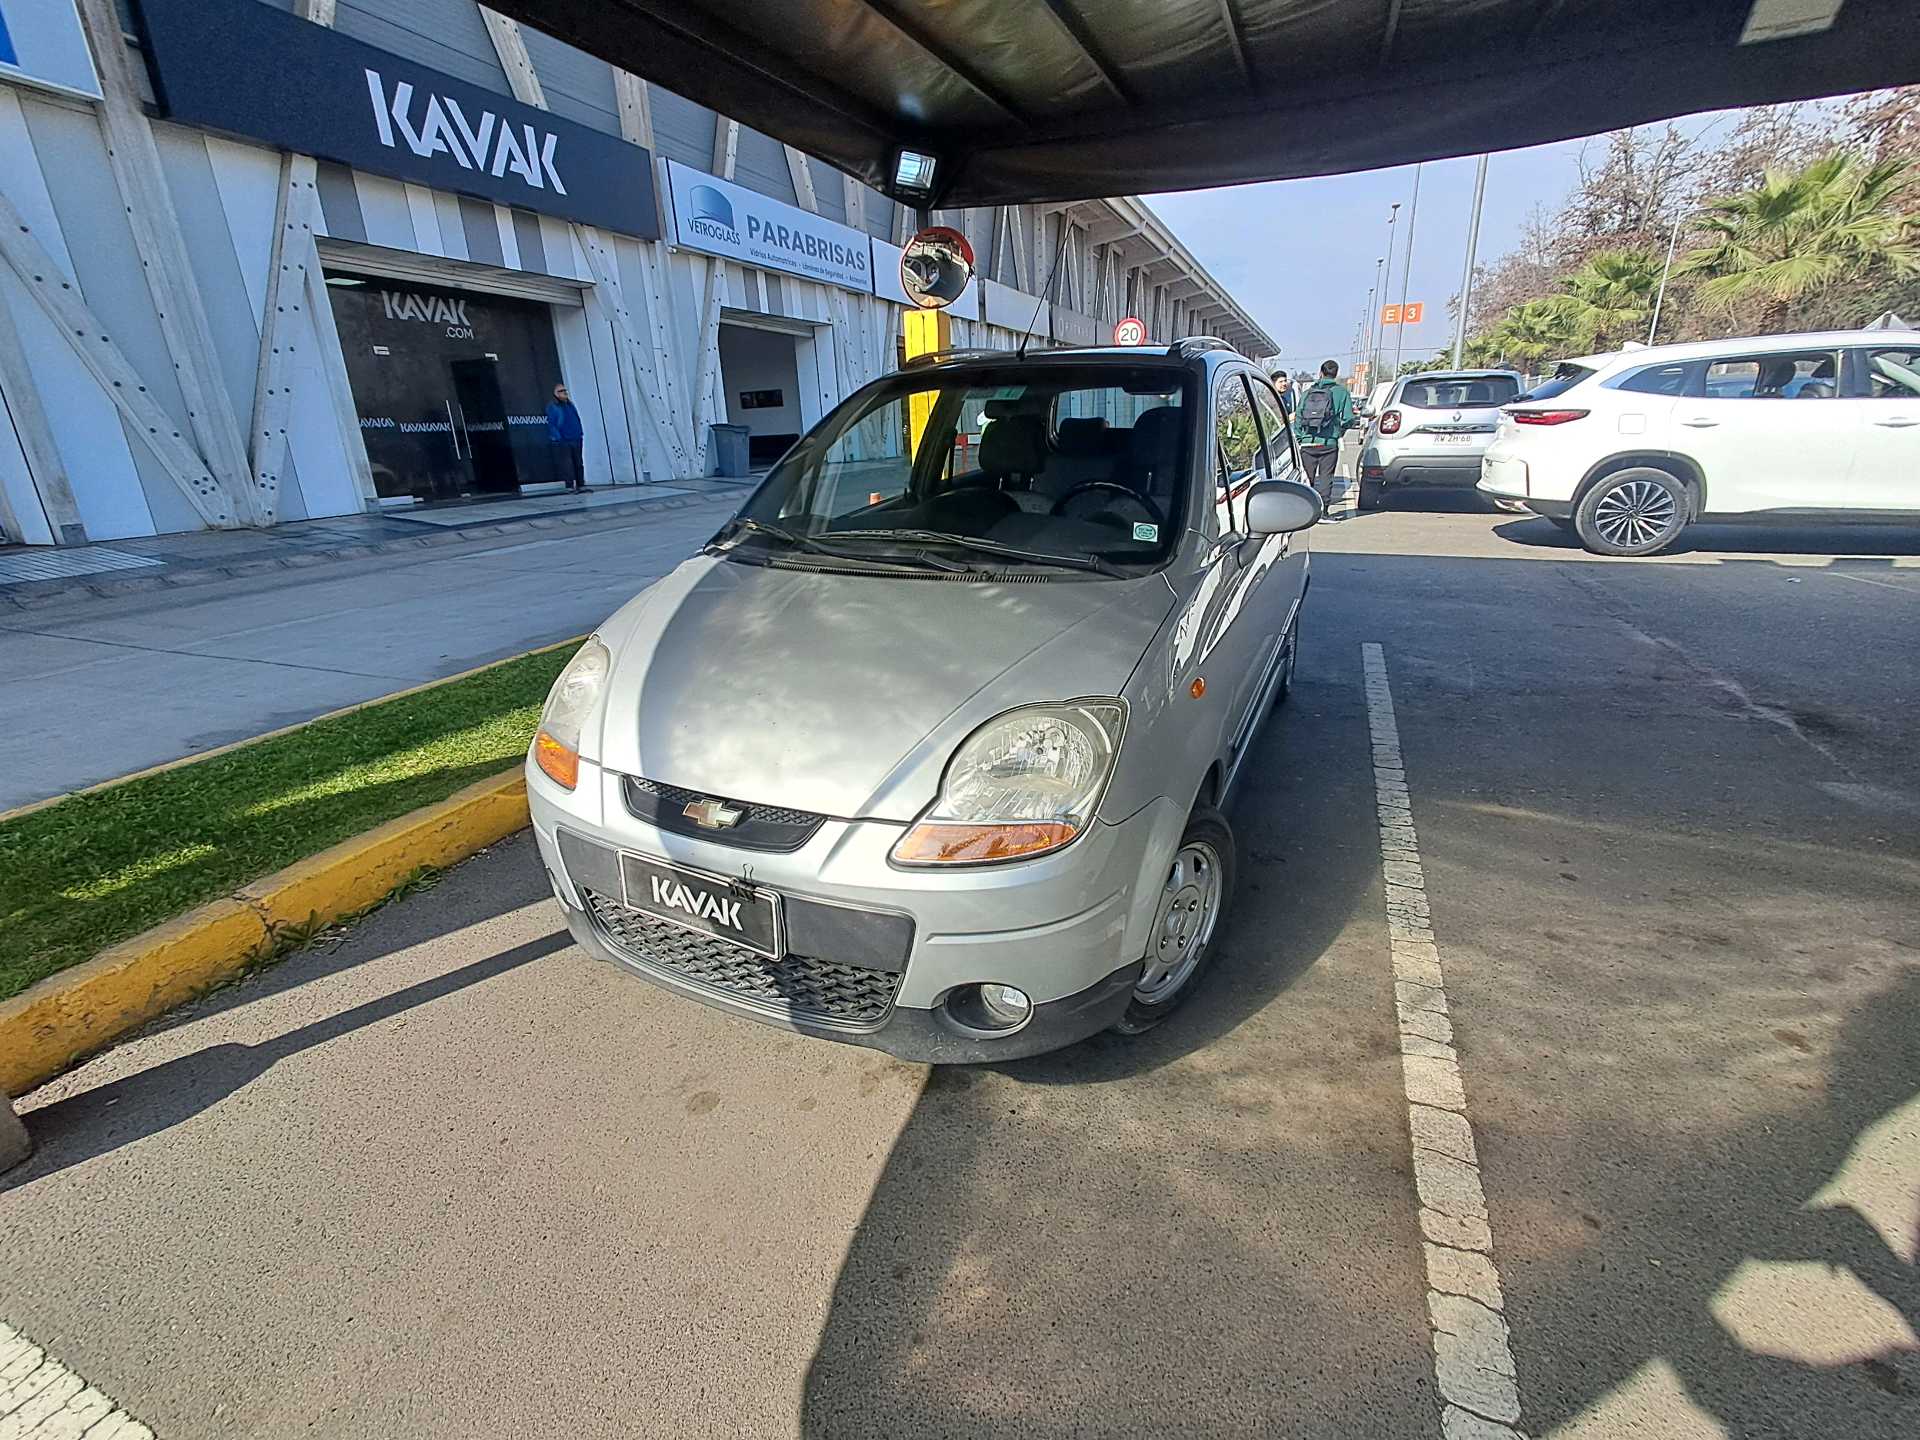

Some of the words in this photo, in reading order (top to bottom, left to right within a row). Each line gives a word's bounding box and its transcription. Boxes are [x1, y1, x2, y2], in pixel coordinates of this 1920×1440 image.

[364, 68, 568, 195] KAVAK
[688, 218, 741, 246] VETROGLASS
[746, 214, 866, 271] PARABRISAS
[381, 290, 471, 326] KAVAK
[1385, 309, 1396, 321] E
[1407, 307, 1417, 320] 3
[445, 327, 474, 340] .COM
[1120, 327, 1139, 342] 20
[651, 875, 743, 931] KAVAK
